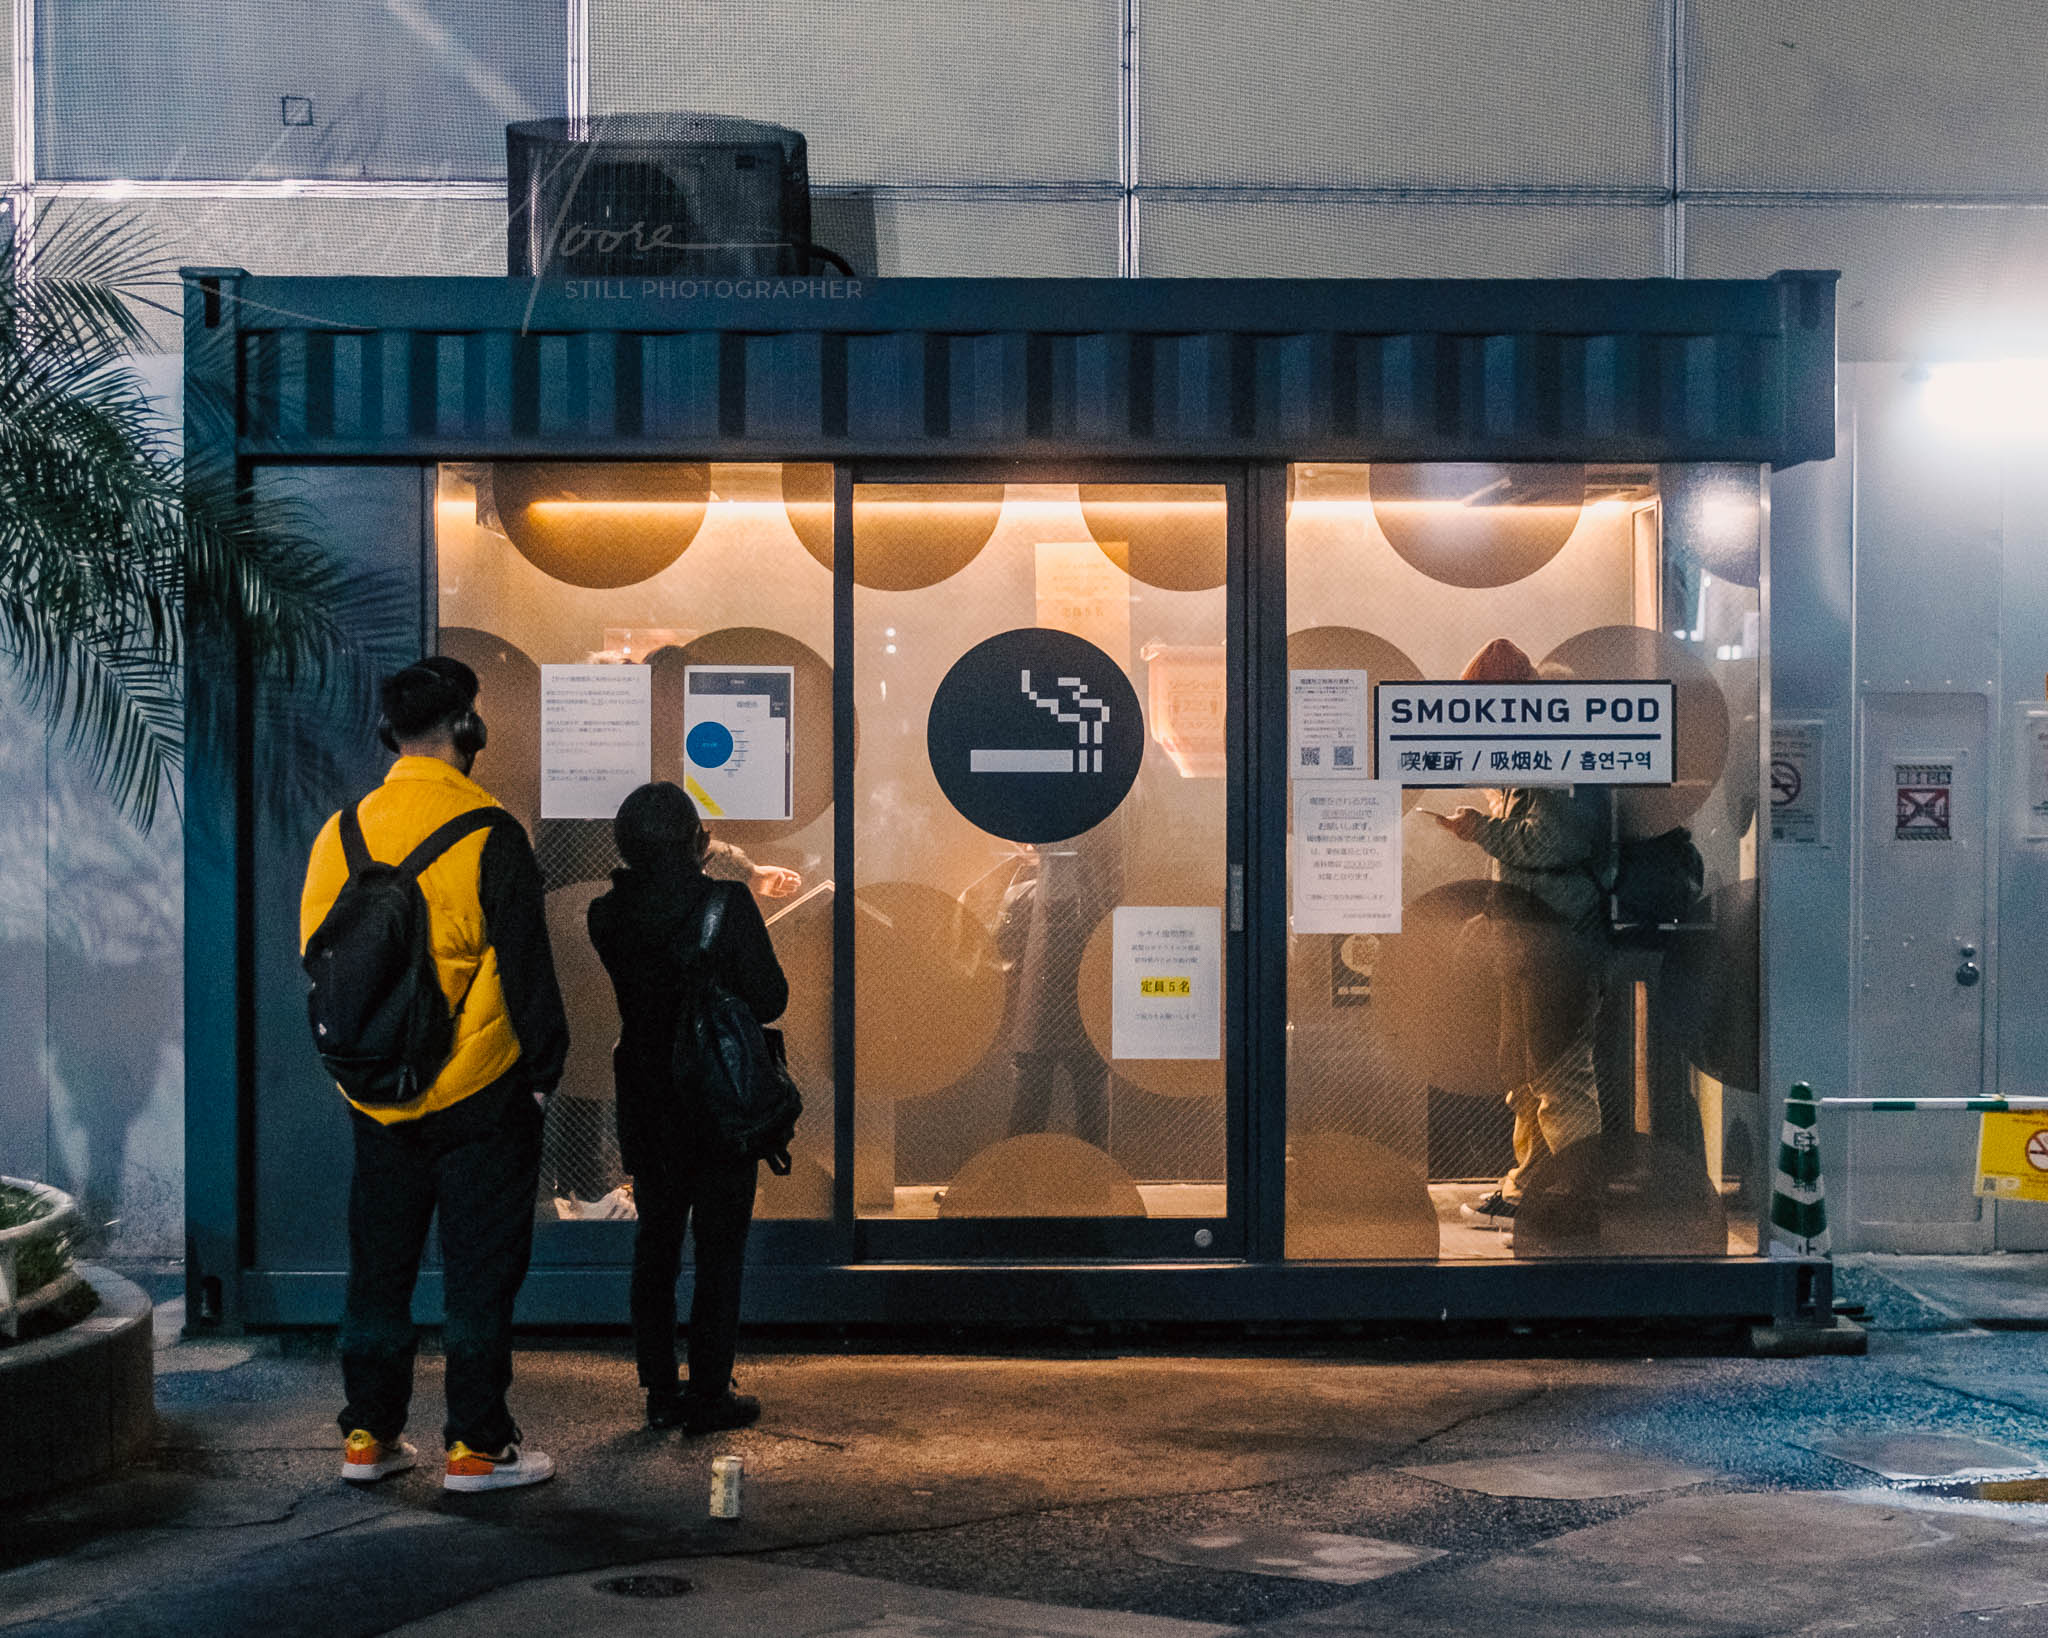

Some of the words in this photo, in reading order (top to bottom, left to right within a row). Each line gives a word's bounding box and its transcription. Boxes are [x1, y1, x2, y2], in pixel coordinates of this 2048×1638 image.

[1391, 697, 1570, 724] SMOKING
[1585, 697, 1660, 723] POD
[1400, 750, 1464, 771] 喫煙所
[1490, 750, 1553, 771] 吸烟处
[1579, 750, 1652, 771] 흡연구역
